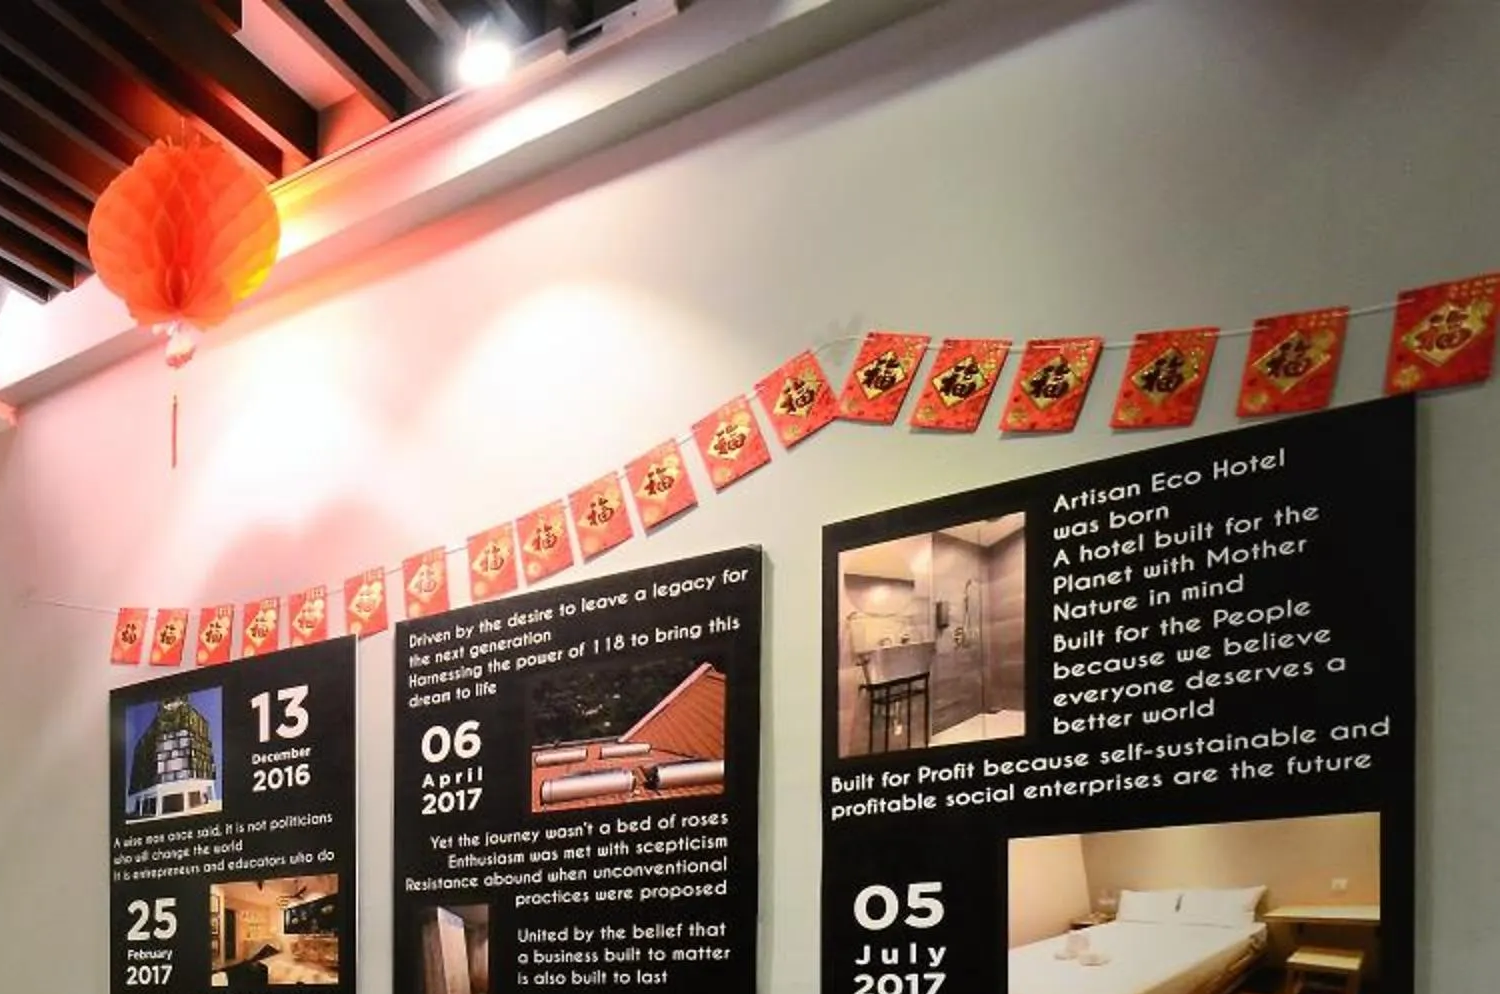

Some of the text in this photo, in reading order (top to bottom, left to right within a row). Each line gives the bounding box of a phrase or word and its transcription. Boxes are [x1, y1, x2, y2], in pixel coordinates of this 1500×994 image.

[1053, 448, 1285, 513] Artisan Eco Hotel
[1053, 506, 1169, 540] was born
[1053, 506, 1319, 568] A hotel built for the
[1053, 539, 1307, 595] Planet with Mother
[409, 570, 749, 649] Driven by the desire to leave a legacy for
[1053, 573, 1244, 622] Nature in mind
[1053, 599, 1310, 653] Built for the People
[409, 631, 552, 668] the next generation
[409, 665, 483, 688] Harnessing
[488, 658, 511, 673] the
[516, 650, 563, 670] power
[568, 642, 586, 659] of
[631, 634, 649, 647] to
[655, 625, 702, 643] bring
[708, 616, 740, 633] this
[1053, 629, 1331, 680] because we believe
[409, 682, 497, 708] dream to life
[1053, 658, 1346, 707] everyone deserves a
[250, 685, 309, 743] 13
[1053, 698, 1214, 735] better world
[252, 747, 311, 765] December
[421, 720, 482, 763] 06
[831, 716, 1389, 793] Built for Profit because self-sustainable and
[253, 764, 311, 792] 2016
[422, 766, 483, 789] April
[831, 754, 1371, 821] profitable social enterprises are the future
[422, 788, 483, 815] 2017
[236, 823, 245, 833] is
[247, 820, 267, 832] not
[270, 813, 333, 831] politicians
[430, 813, 729, 849] Yet the journey wasn't a bed of roses
[203, 849, 335, 873] and educators who do
[213, 839, 243, 854] world
[448, 836, 728, 869] Enthusiasm was met with scepticism
[405, 856, 727, 891] Resistance abound when unconventional
[515, 879, 727, 908] practices were proposed
[854, 881, 945, 931] 05
[127, 897, 177, 941] 25
[518, 922, 726, 943] United by the belief that
[127, 949, 173, 961] February
[517, 946, 731, 964] a business built to matter
[855, 942, 947, 967] July
[126, 965, 173, 985] 2017
[533, 971, 567, 985] also
[571, 970, 607, 985] built
[613, 972, 631, 985] to
[637, 969, 668, 984] last
